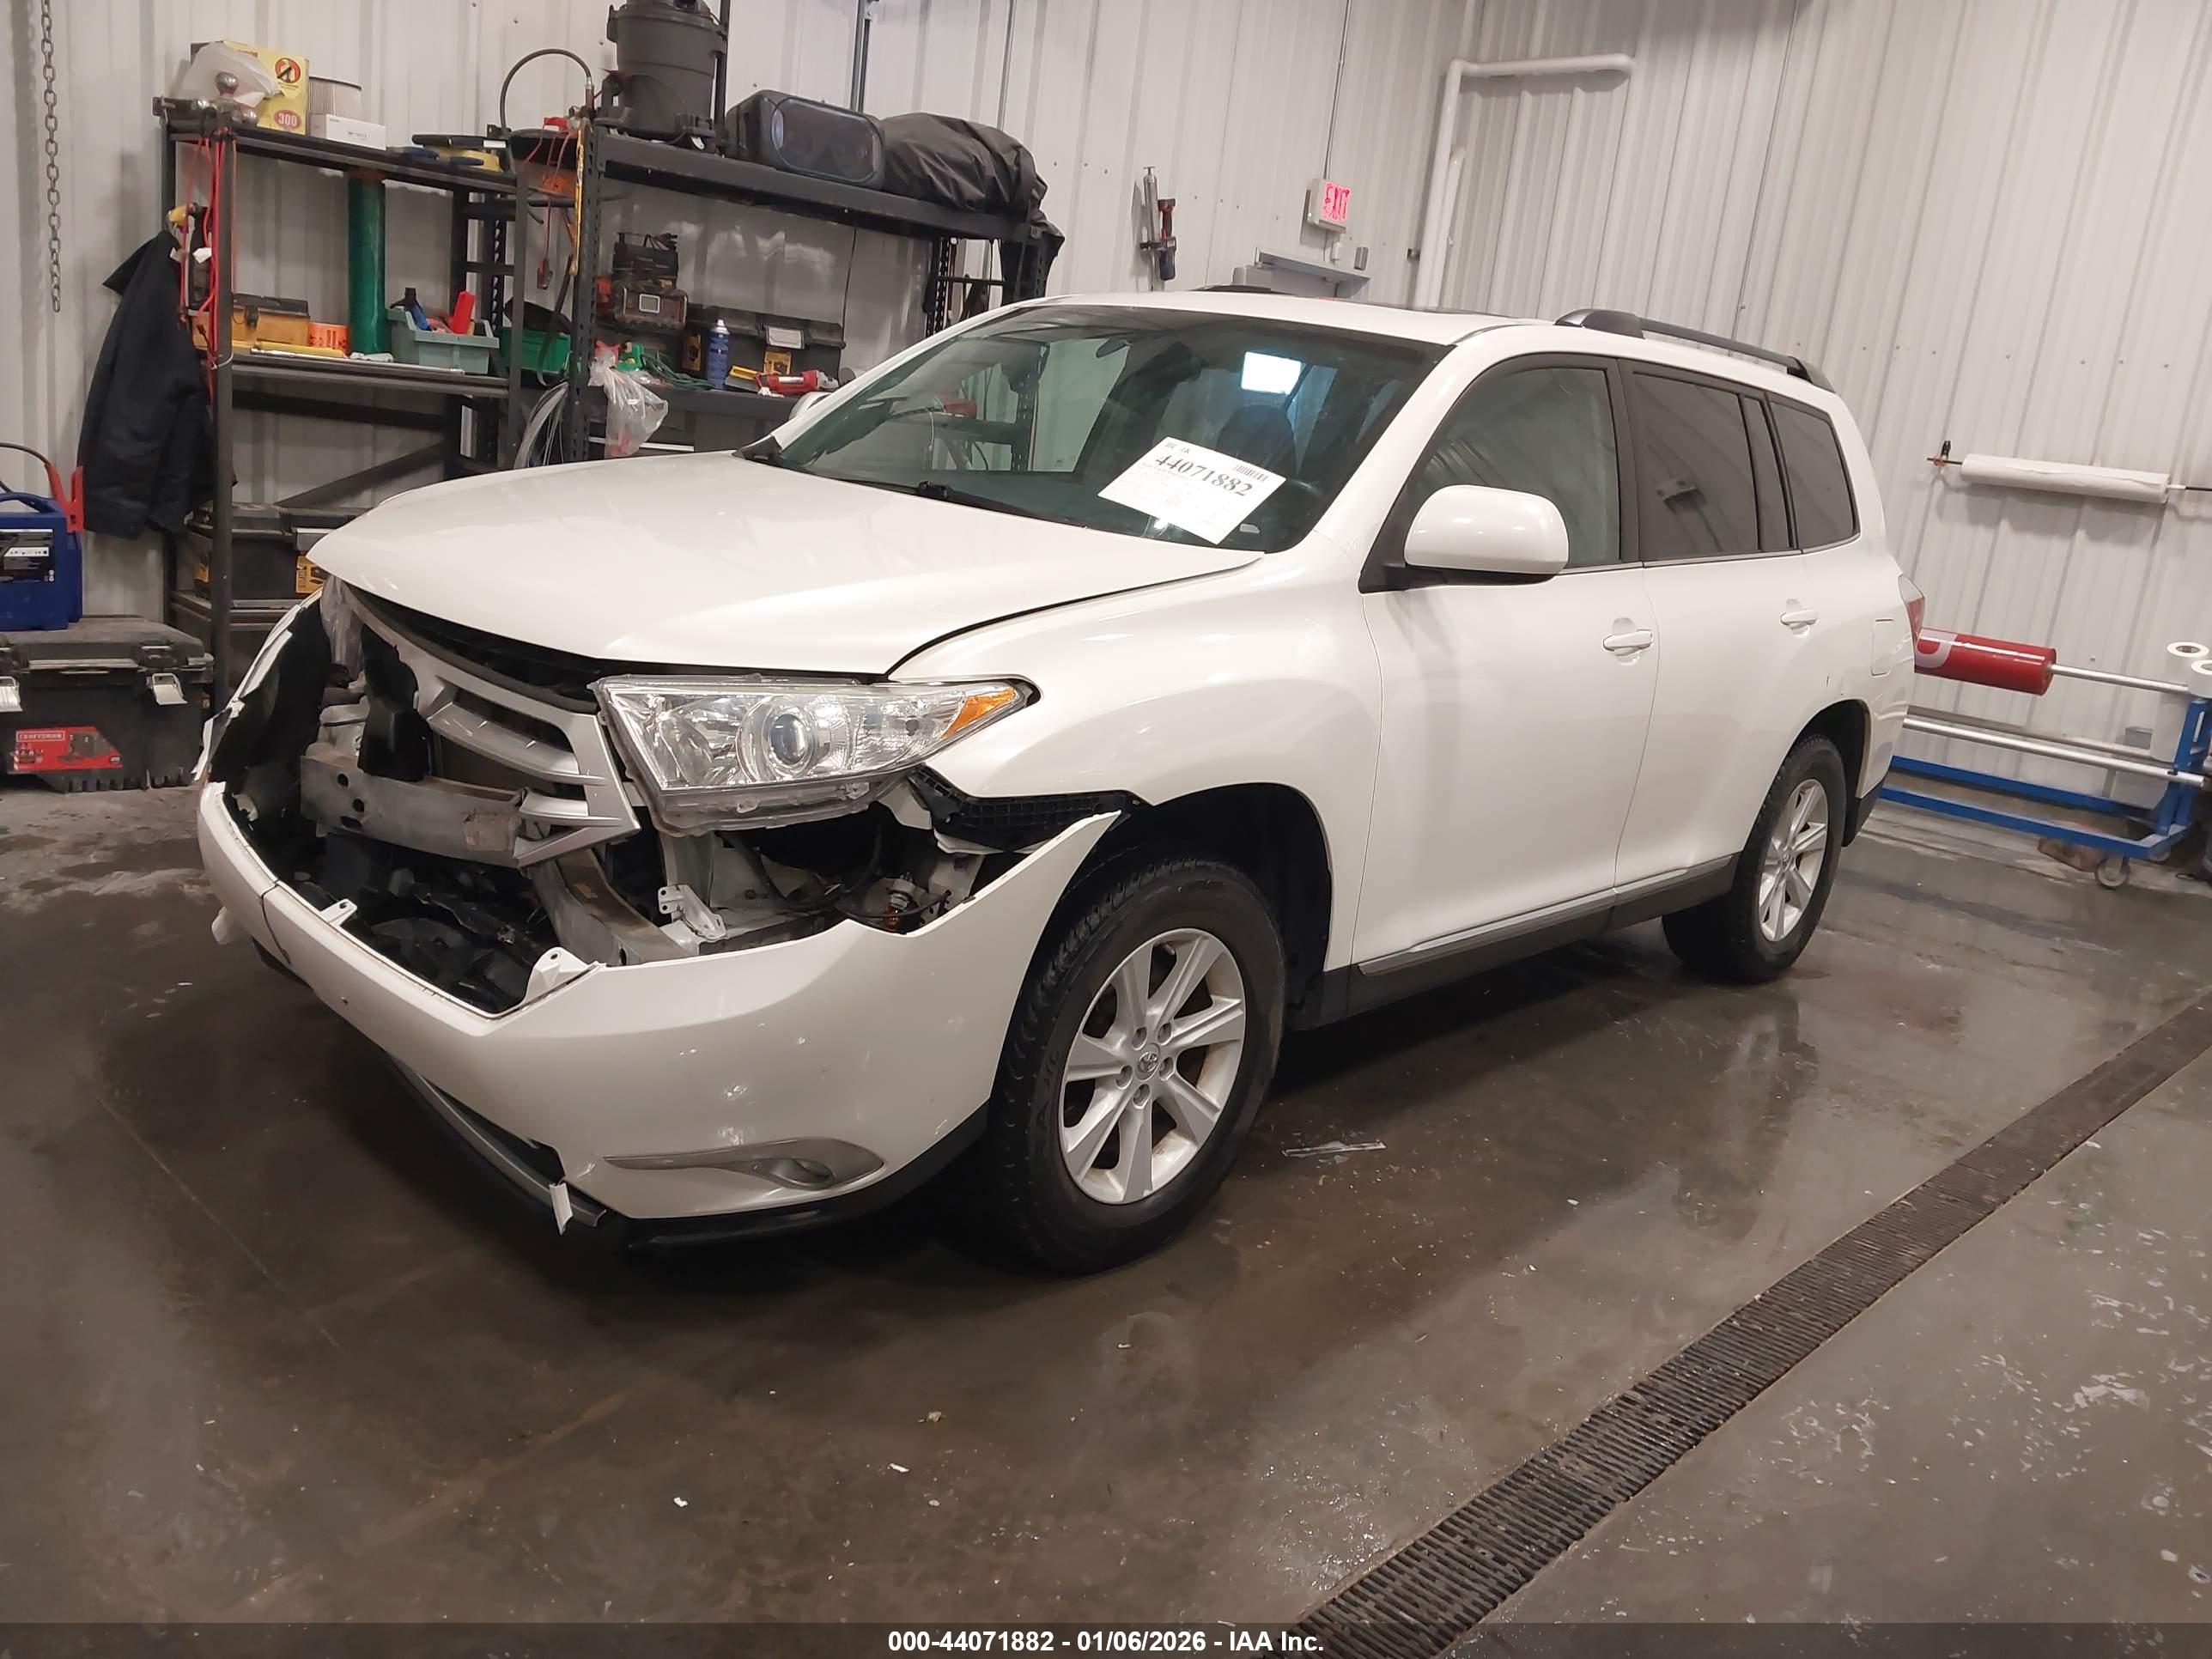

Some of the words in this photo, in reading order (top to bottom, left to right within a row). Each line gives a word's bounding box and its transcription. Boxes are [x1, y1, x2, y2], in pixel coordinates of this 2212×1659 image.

[277, 112, 298, 127] 300
[1322, 182, 1351, 222] EXIT
[1155, 454, 1253, 496] 44071882
